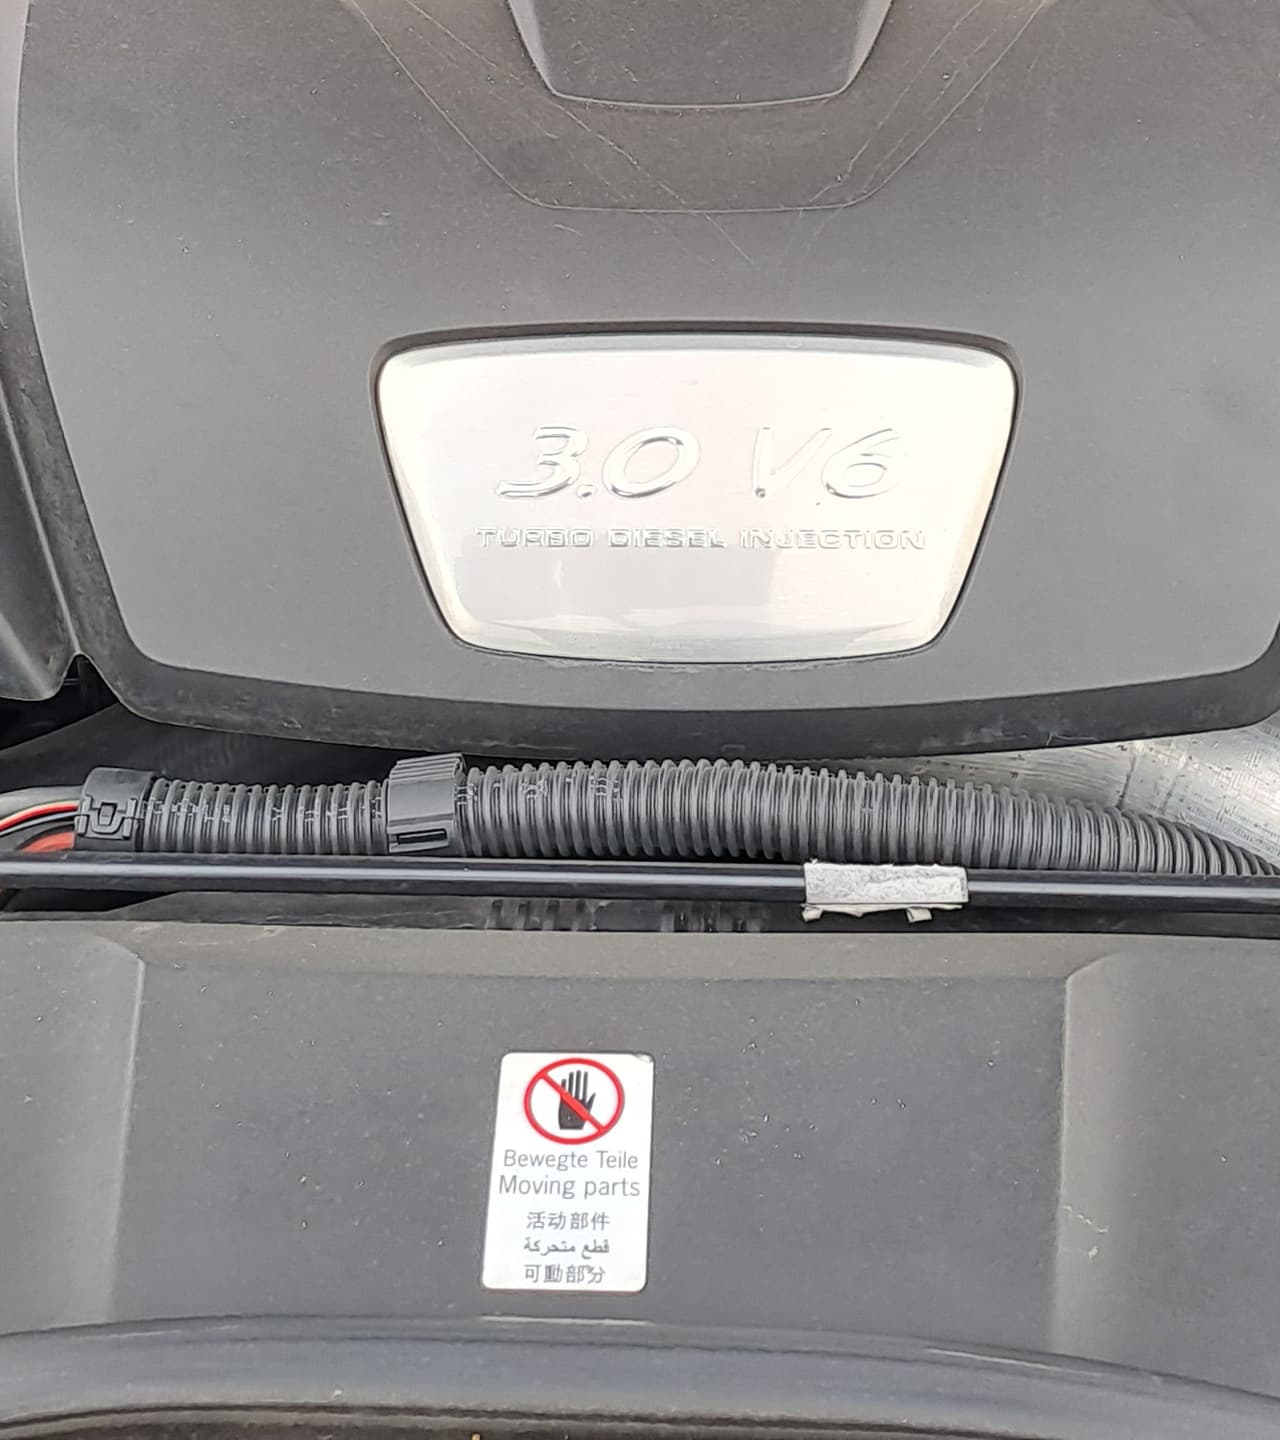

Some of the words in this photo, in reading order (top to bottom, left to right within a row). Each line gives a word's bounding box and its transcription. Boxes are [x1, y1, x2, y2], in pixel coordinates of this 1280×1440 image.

[495, 425, 701, 500] 3.0
[751, 425, 902, 500] V6
[474, 527, 595, 549] TURBO
[607, 527, 728, 549] DIESEL
[739, 528, 927, 551] INJECTION
[503, 1149, 588, 1171] Bewegte
[596, 1150, 638, 1169] Teile
[499, 1174, 575, 1199] Moving
[584, 1177, 640, 1200] parts
[526, 1211, 610, 1231] 活动部件
[581, 1239, 610, 1260] قطع
[523, 1263, 606, 1284] 可動部分
